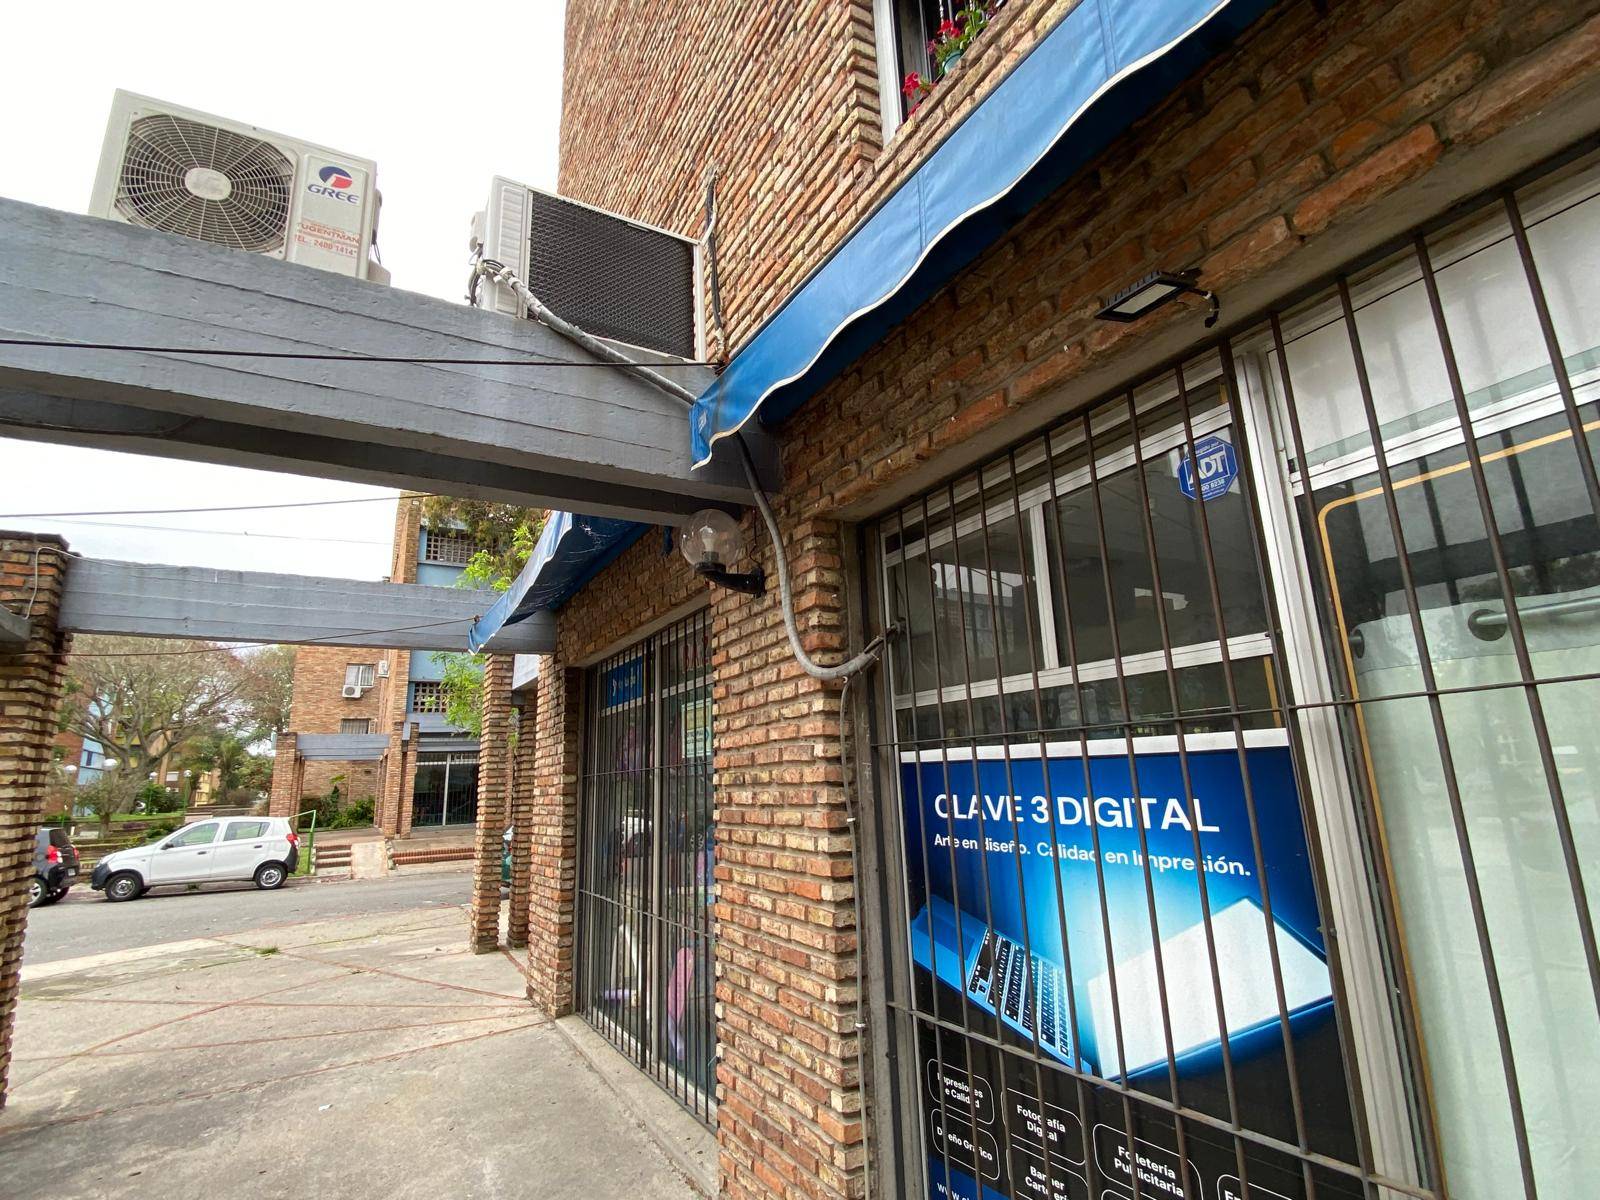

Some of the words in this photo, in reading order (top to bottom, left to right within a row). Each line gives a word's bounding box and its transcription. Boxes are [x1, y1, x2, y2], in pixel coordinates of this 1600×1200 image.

[307, 183, 360, 204] GREE
[1189, 450, 1226, 485] ADT
[934, 793, 1024, 822] CLAVE
[1030, 795, 1050, 824] 3
[1056, 796, 1220, 833] DIGITAL
[961, 838, 978, 850] en
[1104, 850, 1129, 865] en
[950, 1088, 980, 1109] Calidd
[936, 1126, 962, 1147] Deño
[1026, 1120, 1058, 1142] Digal
[1113, 1157, 1184, 1198] Pulicitaria
